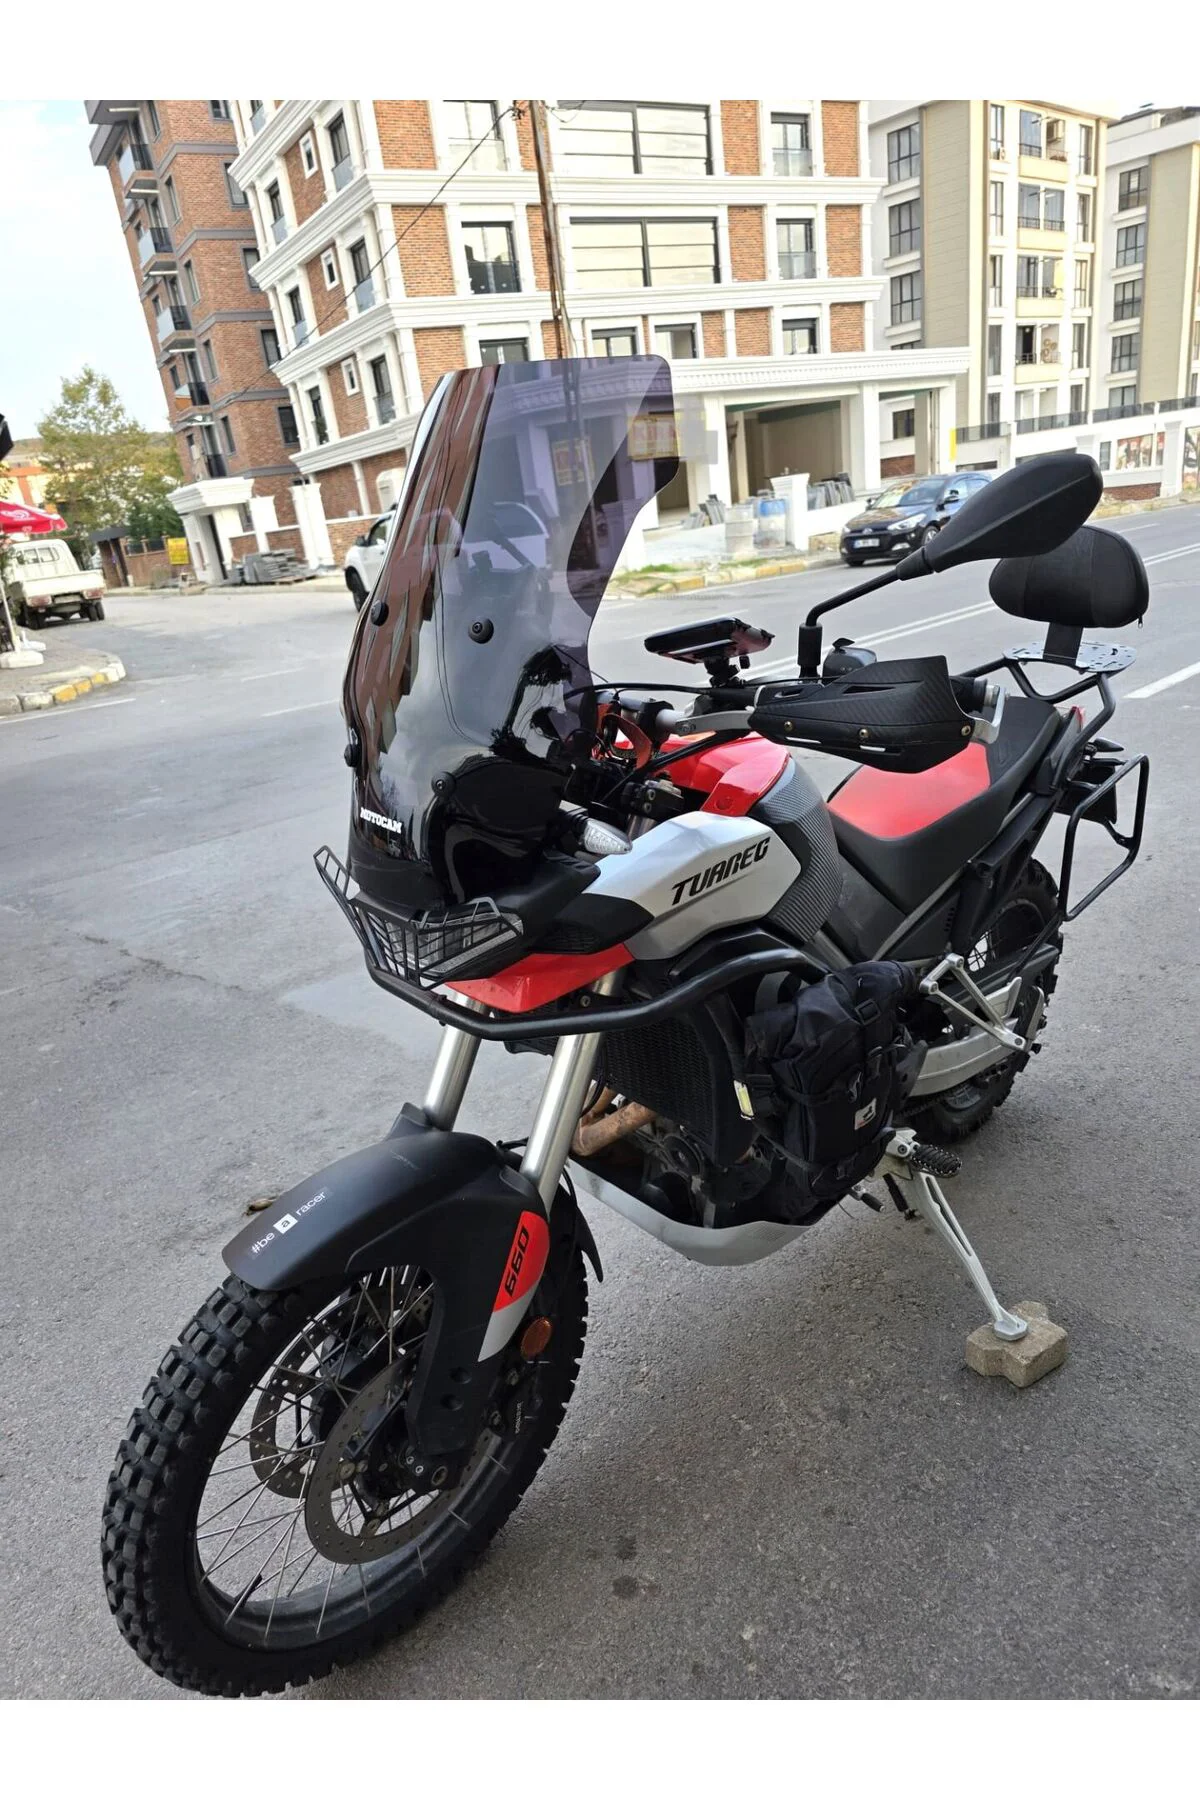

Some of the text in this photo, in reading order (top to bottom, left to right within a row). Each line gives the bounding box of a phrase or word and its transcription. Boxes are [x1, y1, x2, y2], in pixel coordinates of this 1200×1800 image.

[360, 806, 402, 834] MOTOCAM
[671, 836, 771, 906] TUAREG
[251, 1232, 275, 1254] #be
[295, 1191, 326, 1216] racer
[504, 1225, 530, 1298] 660
